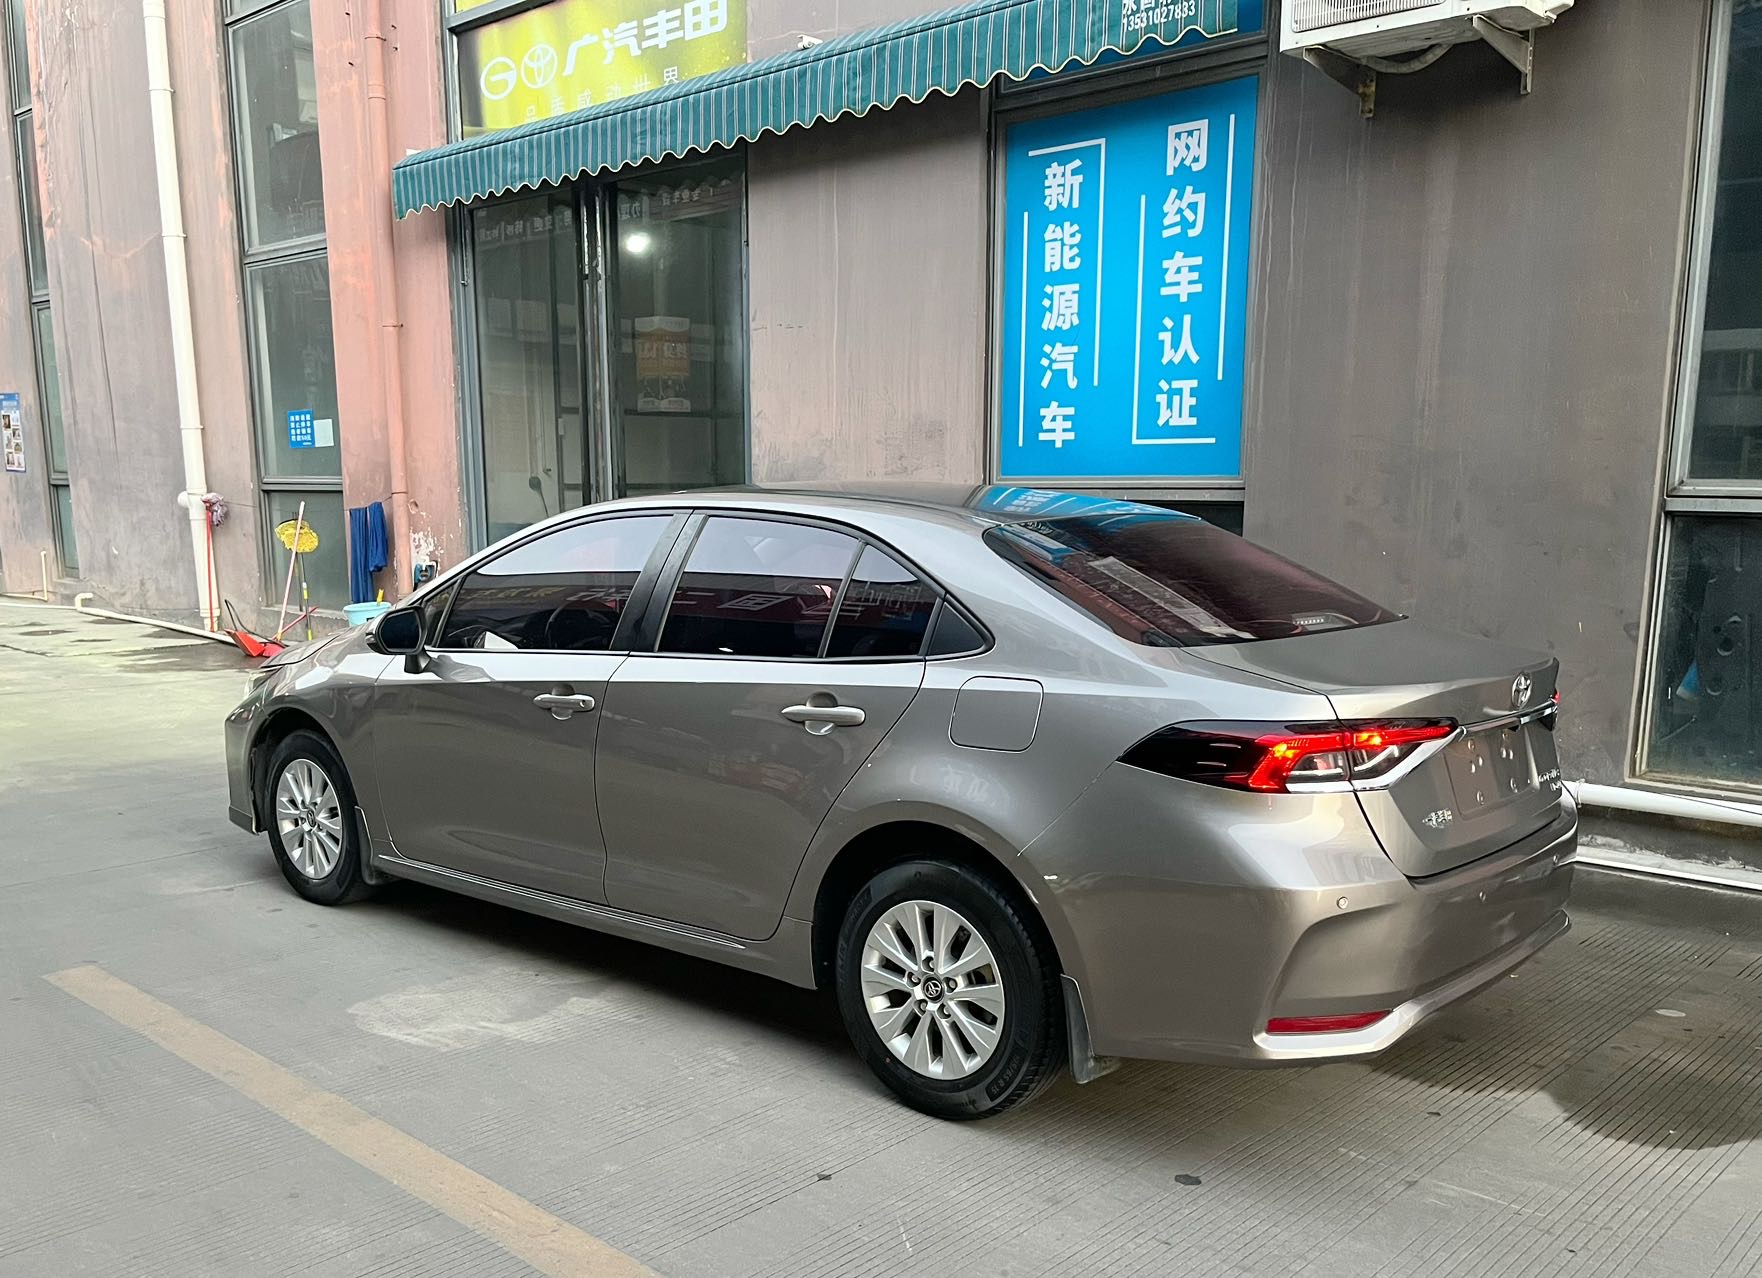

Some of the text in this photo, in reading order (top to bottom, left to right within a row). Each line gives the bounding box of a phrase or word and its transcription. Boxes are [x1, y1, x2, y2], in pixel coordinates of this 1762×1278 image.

[562, 0, 728, 76] 广汽丰田
[1038, 158, 1084, 448] 新能源汽车
[1155, 118, 1209, 428] 网约车认证
